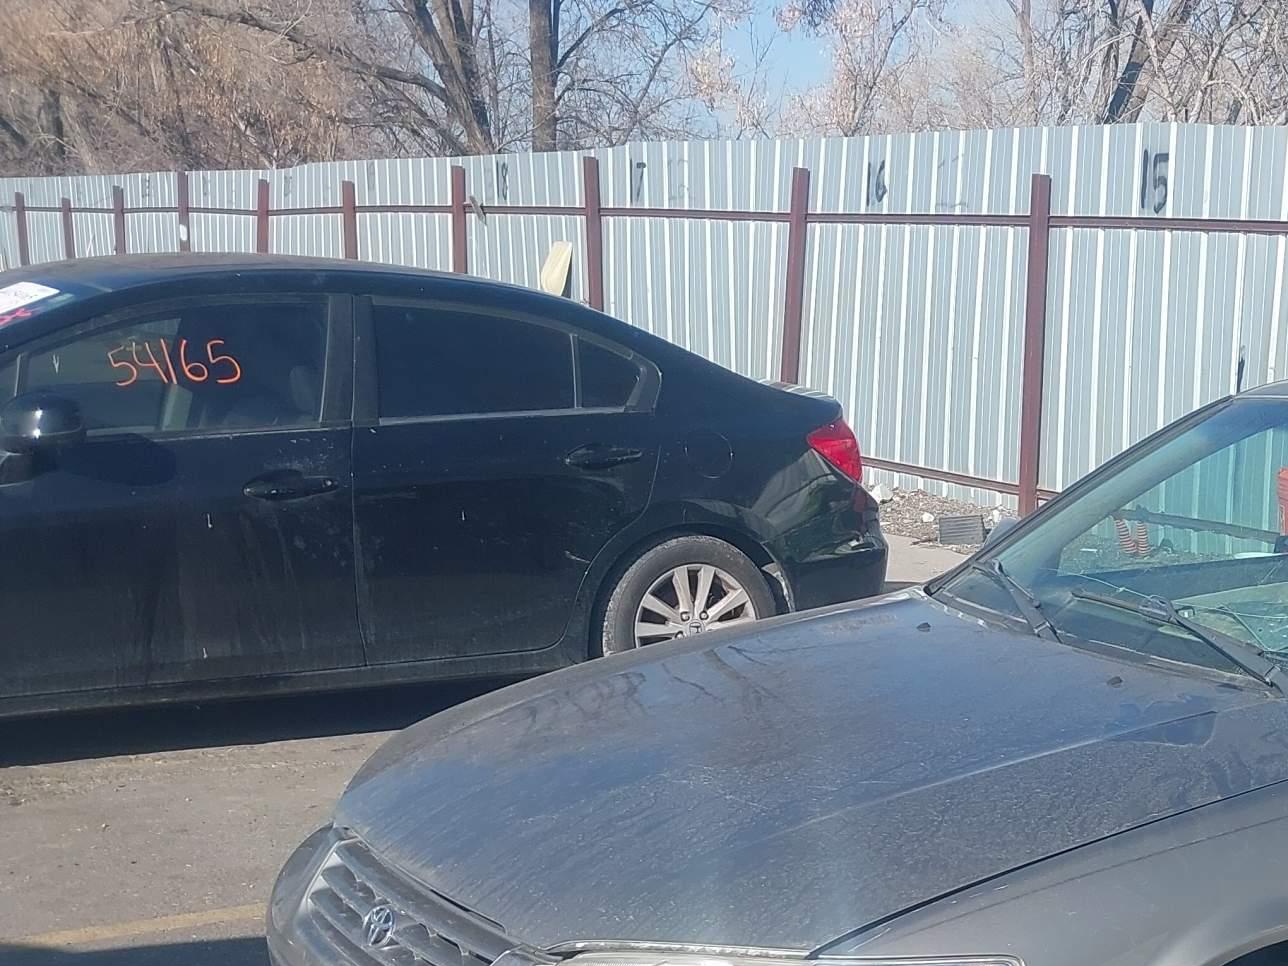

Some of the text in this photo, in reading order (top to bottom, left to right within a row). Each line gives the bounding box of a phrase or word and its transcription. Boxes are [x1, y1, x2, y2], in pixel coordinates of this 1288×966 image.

[865, 159, 888, 207] 16
[1140, 148, 1170, 214] 15
[107, 337, 242, 386] 54165
